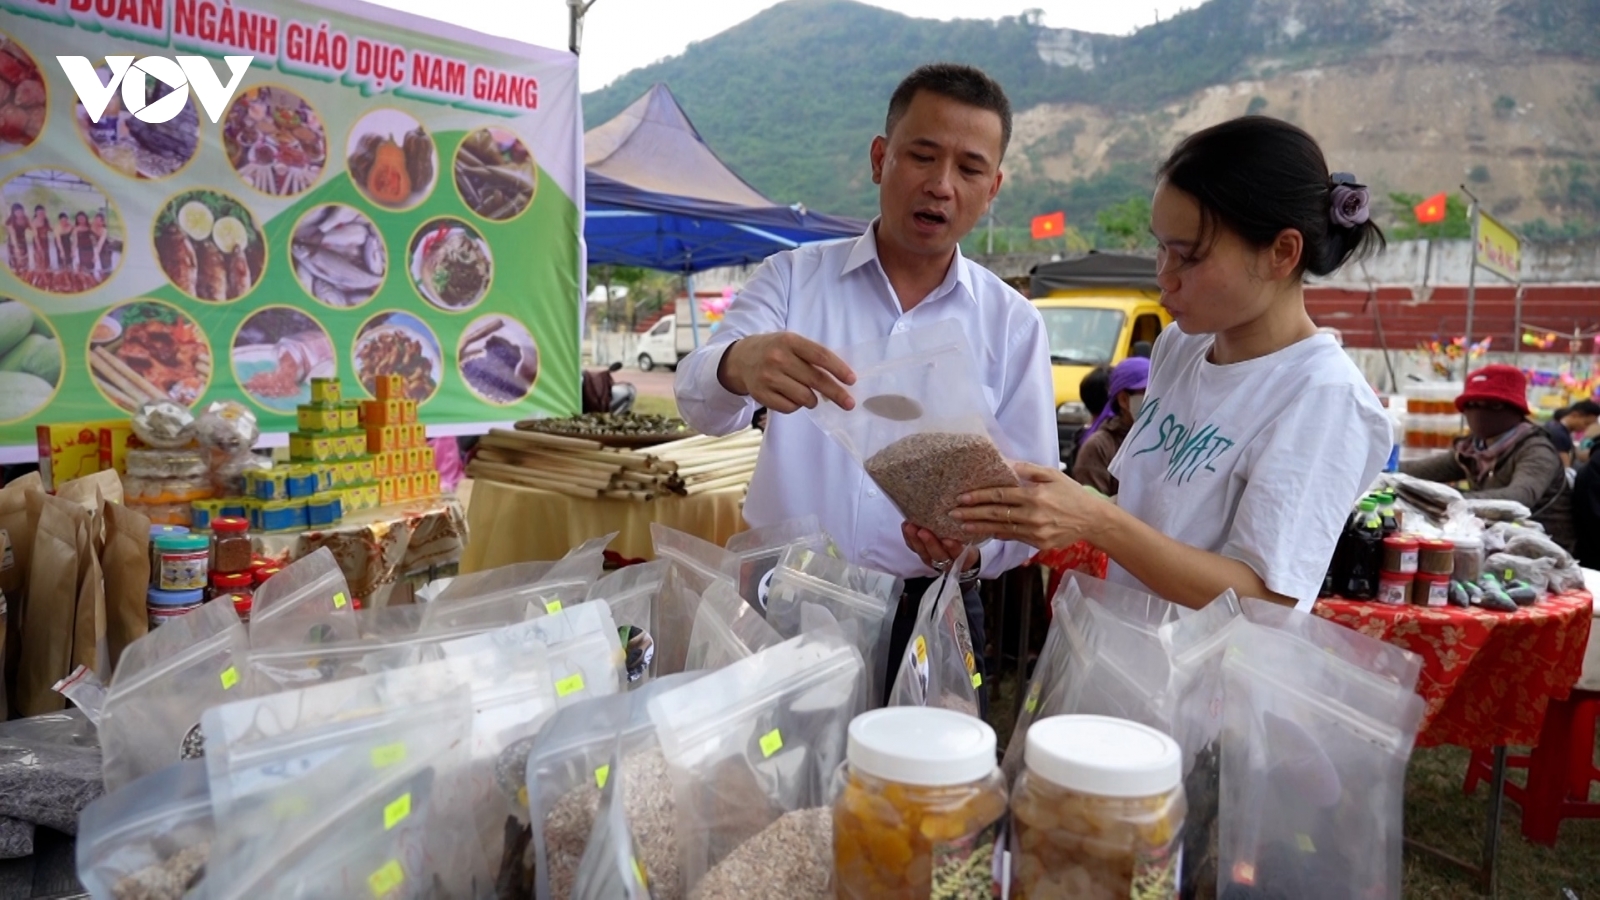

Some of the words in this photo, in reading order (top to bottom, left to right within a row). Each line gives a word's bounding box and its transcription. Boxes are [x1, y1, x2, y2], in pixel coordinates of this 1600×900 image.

[174, 0, 278, 56] NGÀNH
[286, 23, 347, 71] GIÁO
[356, 40, 405, 87] DỤC
[412, 53, 466, 96] NAM
[473, 68, 538, 110] GIANG
